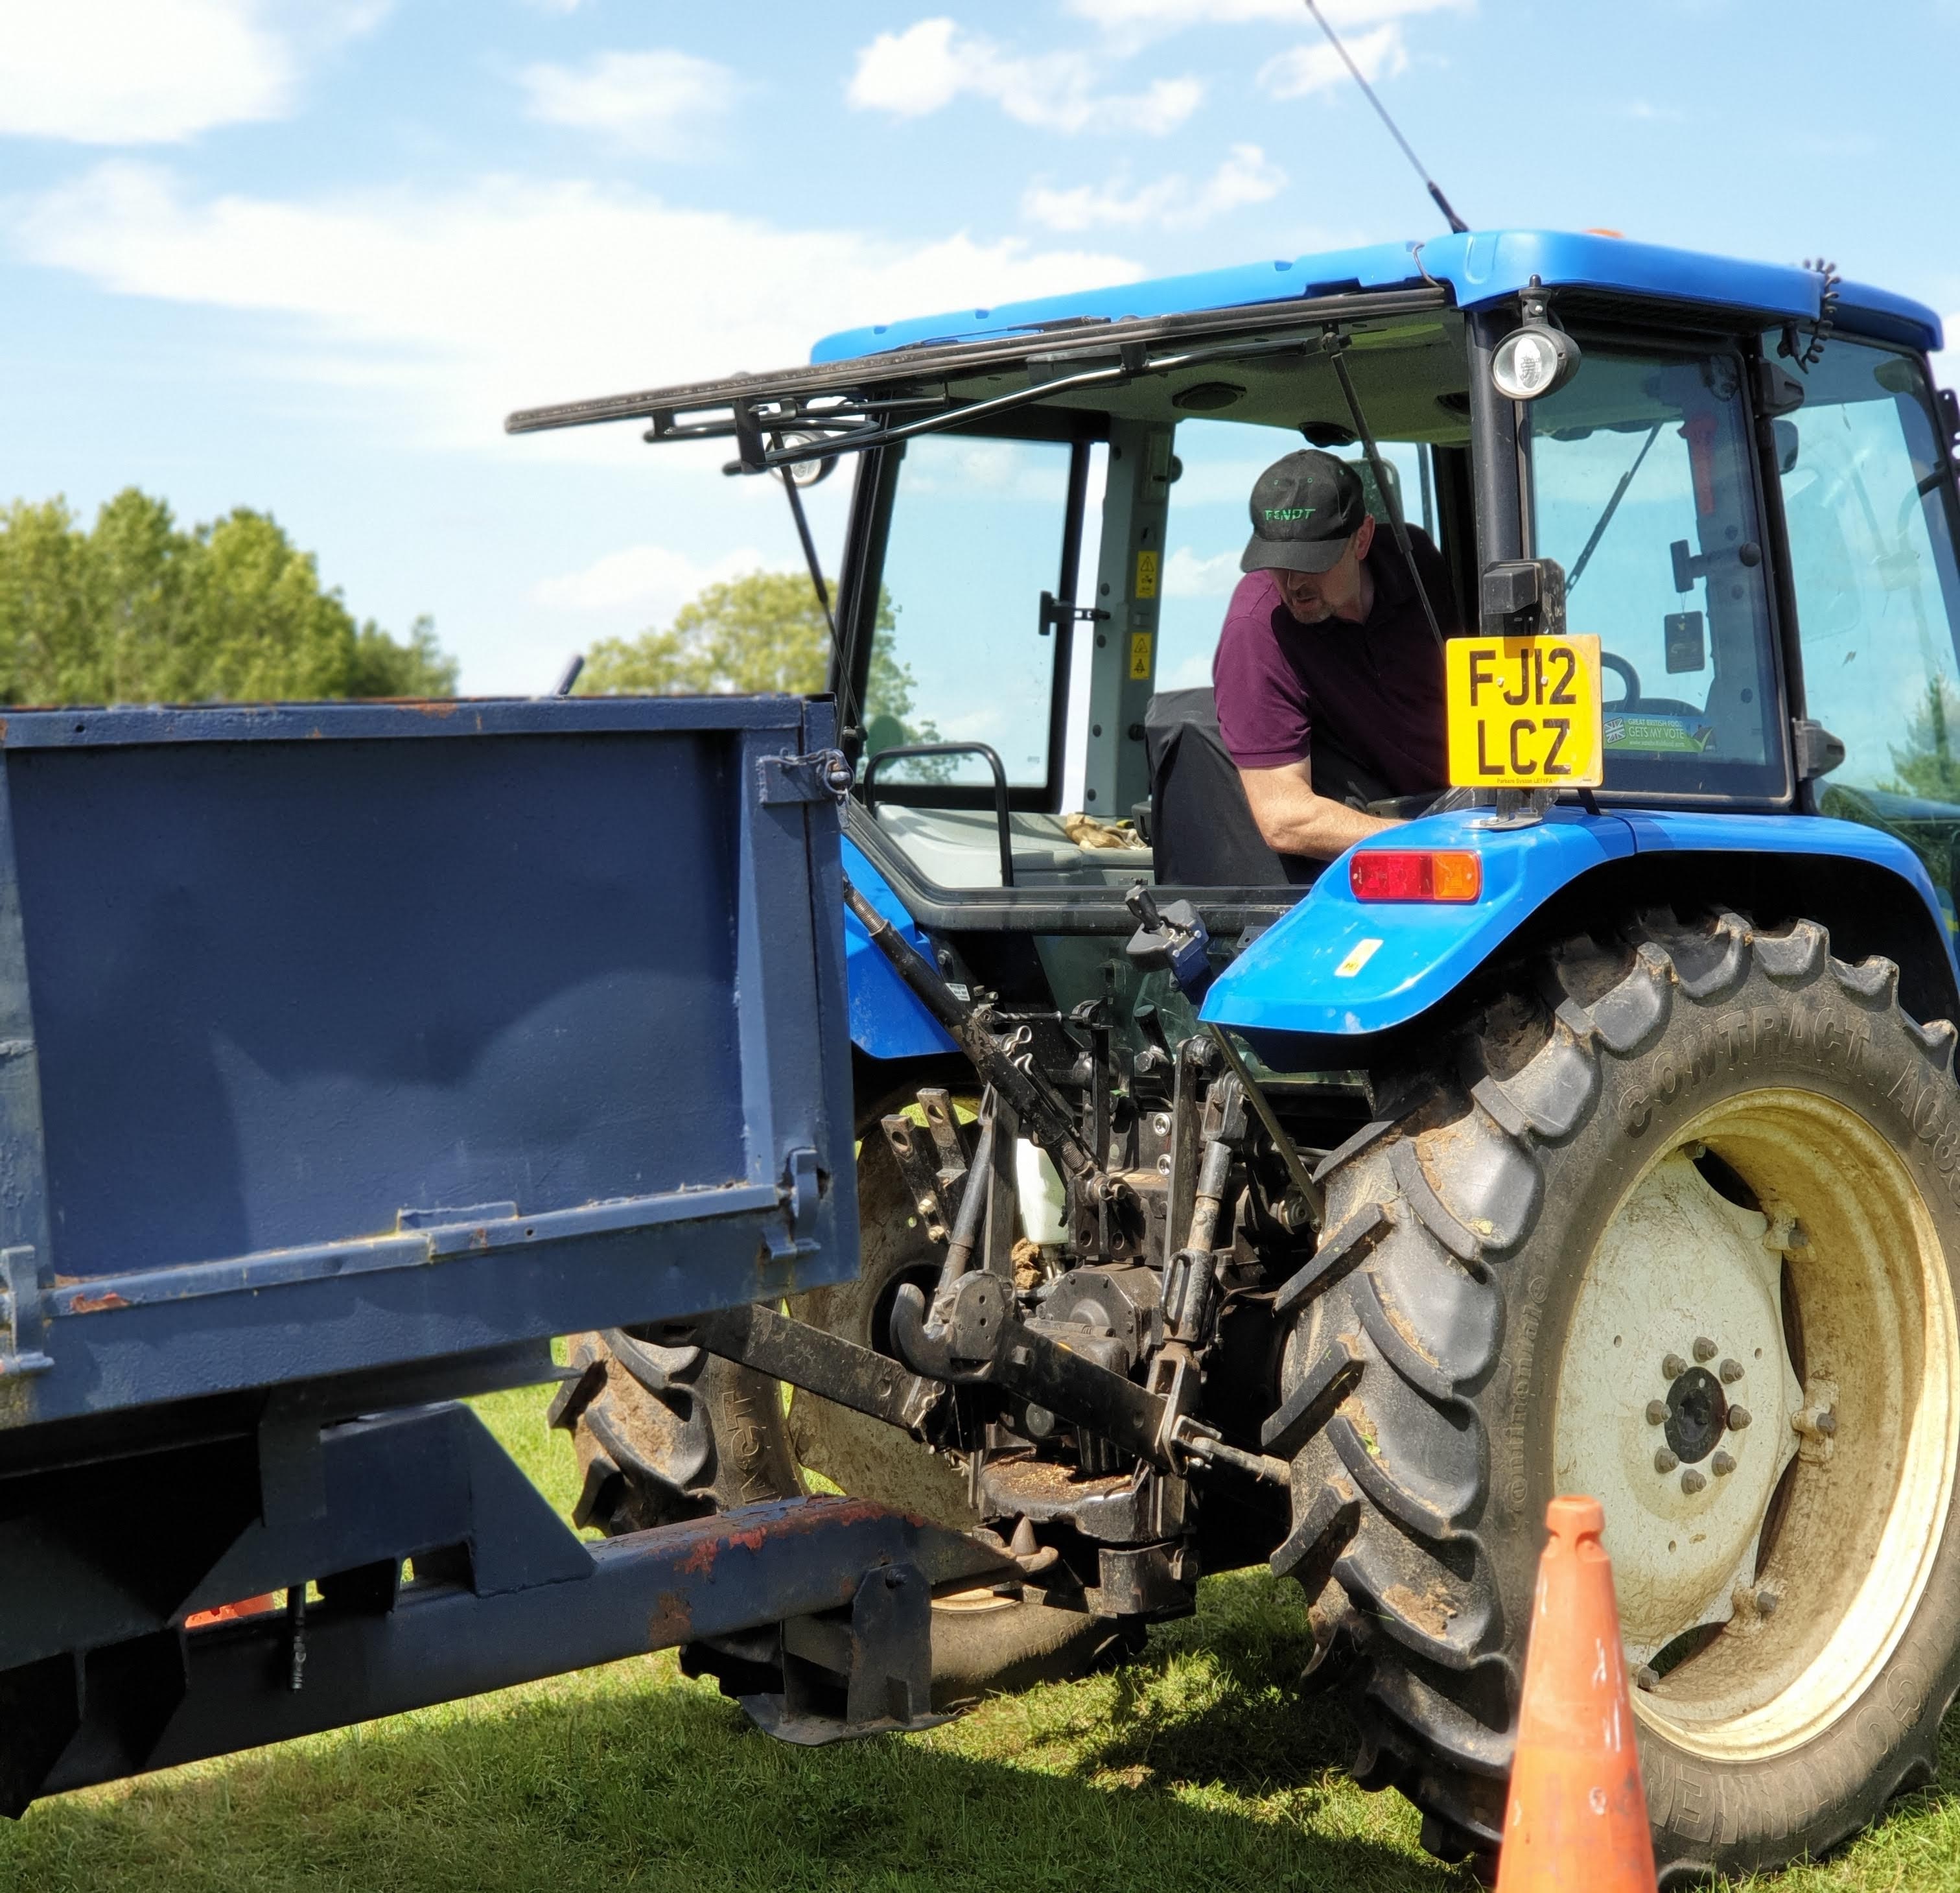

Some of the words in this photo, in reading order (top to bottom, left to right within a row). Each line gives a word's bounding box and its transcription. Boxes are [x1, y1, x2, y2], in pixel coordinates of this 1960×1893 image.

[1265, 508, 1316, 521] FENDT
[1469, 648, 1576, 707] FJ12
[1477, 718, 1571, 775] LCZ
[1628, 726, 1649, 738] GETS
[1650, 727, 1662, 738] MY
[1663, 728, 1685, 739] VOTE
[1619, 1002, 1871, 1139] CONTRACT
